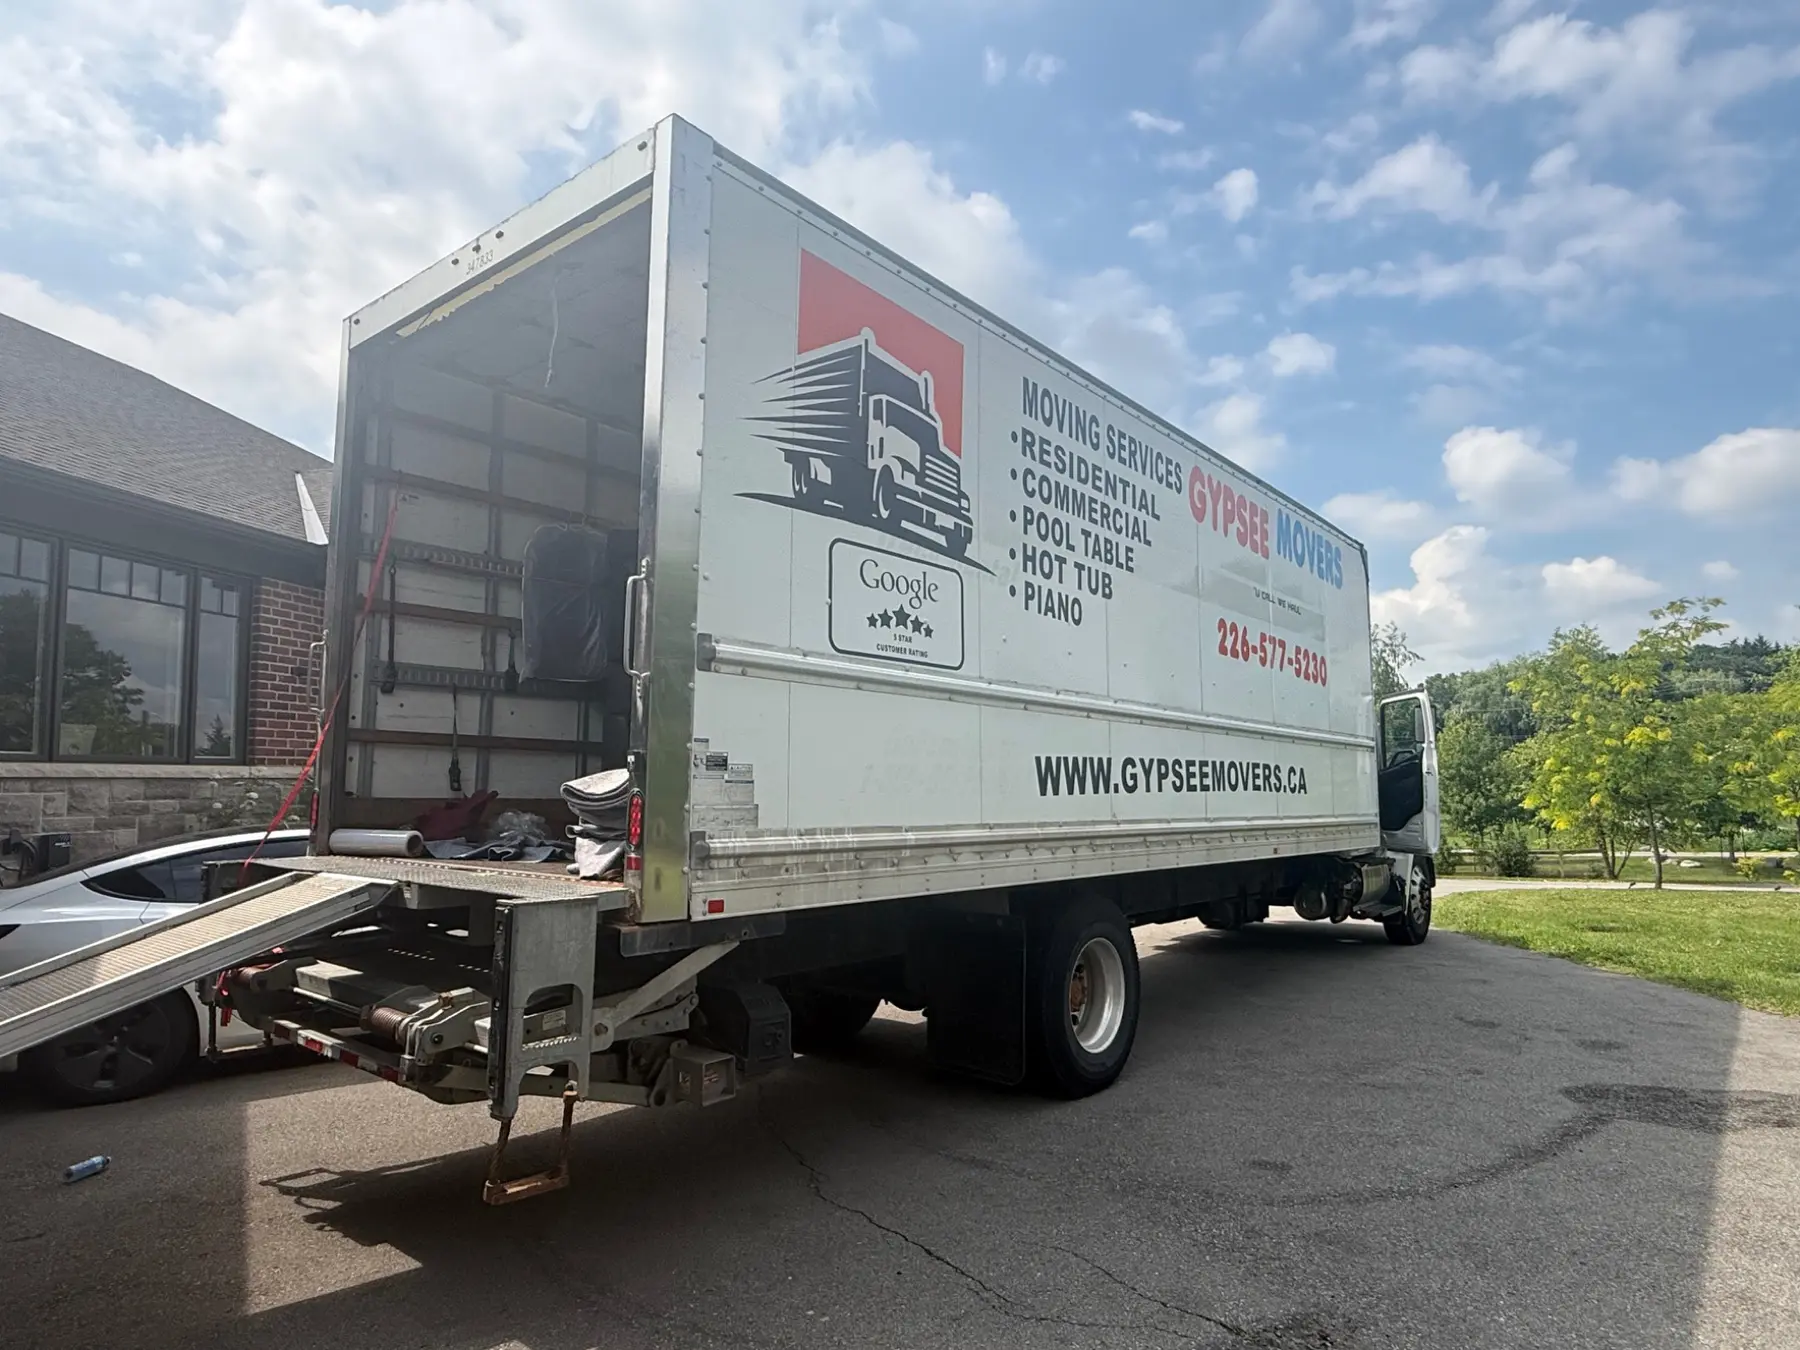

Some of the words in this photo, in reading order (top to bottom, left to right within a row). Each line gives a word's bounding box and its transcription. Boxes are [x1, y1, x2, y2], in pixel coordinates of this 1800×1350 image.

[1022, 376, 1100, 452] MOVING
[1105, 423, 1183, 495] SERVICES
[1021, 426, 1161, 521] RESIDENTIAL
[1022, 468, 1152, 547] COMMERCIAL
[1023, 505, 1075, 553] POOL
[1080, 528, 1135, 573] TABLE
[1188, 465, 1271, 560] GYPSEE
[1276, 507, 1343, 590] MOVERS
[859, 559, 938, 609] Google
[1022, 542, 1067, 584] HOT
[1073, 561, 1113, 600] TUB
[1023, 580, 1083, 627] PIANO
[876, 643, 907, 654] CUSTOMER
[908, 647, 928, 658] RATING
[898, 634, 912, 643] STAR
[1216, 618, 1328, 687] 226-577-5230
[1034, 756, 1308, 795] WWW.GYPSEEMOVERS.CA
